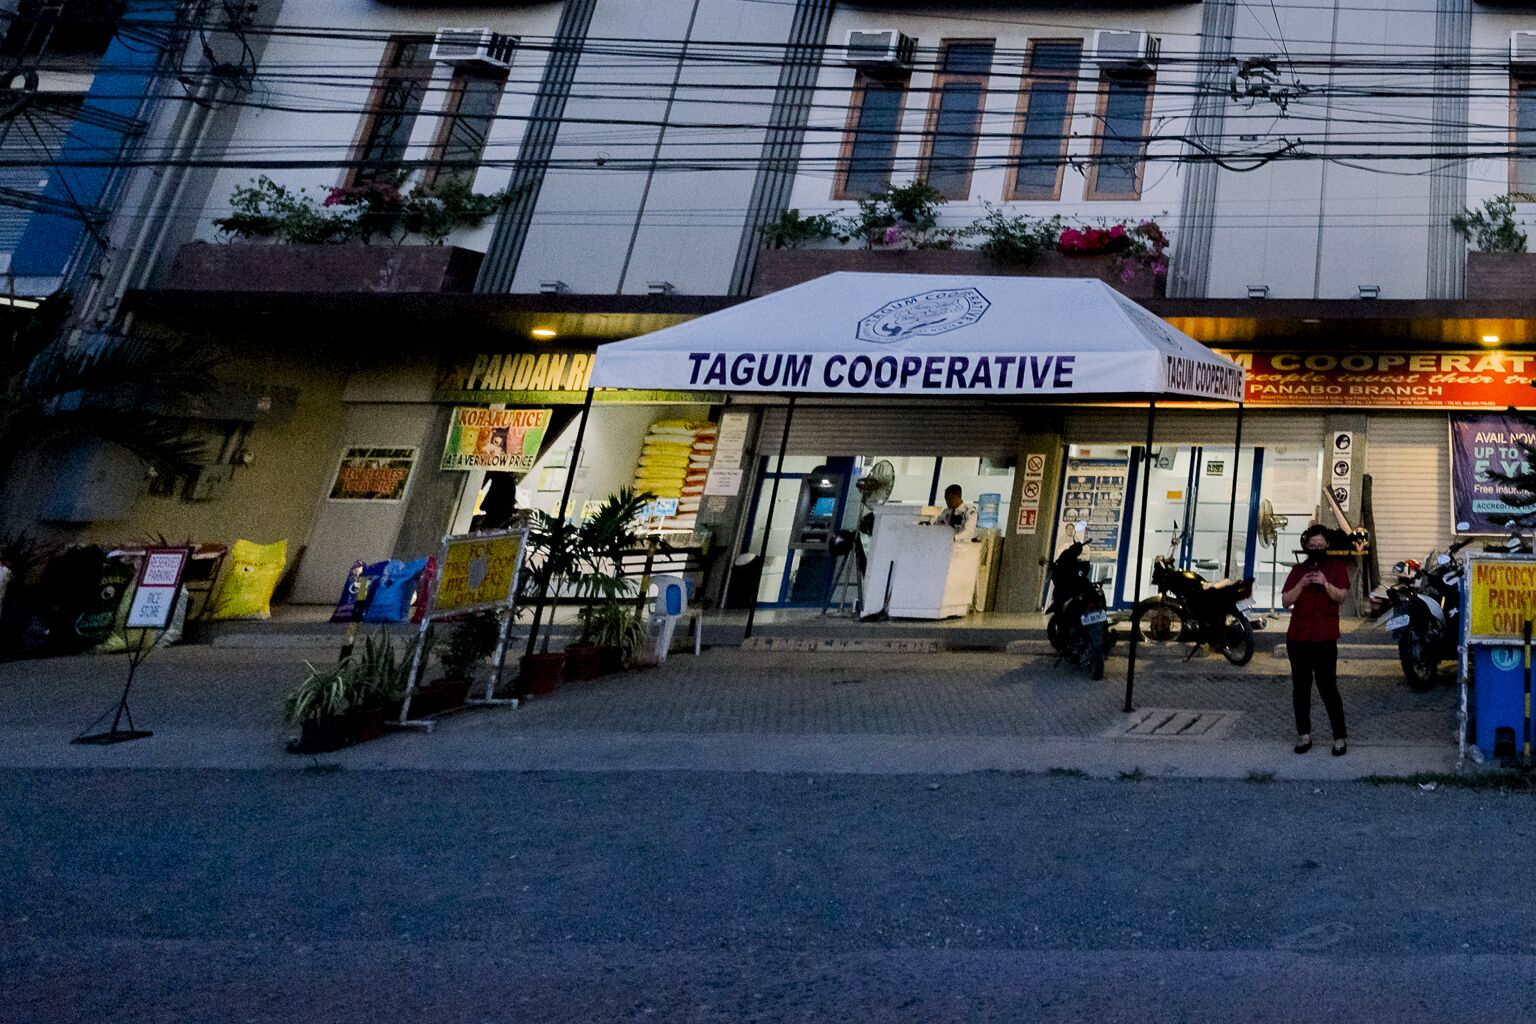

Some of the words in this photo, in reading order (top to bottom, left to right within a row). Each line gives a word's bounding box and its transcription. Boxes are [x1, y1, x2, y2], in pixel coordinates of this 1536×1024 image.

[466, 353, 568, 391] PANDAN
[687, 352, 813, 387] TAGUM
[822, 354, 1076, 389] COOPERATIVE
[1166, 355, 1195, 391] TAGUM
[1195, 360, 1243, 398] COOPERATIVE
[1249, 383, 1342, 395] PANABO
[1349, 384, 1443, 396] BRANCH
[514, 410, 544, 427] RICE
[1474, 431, 1508, 444] AVAIL
[464, 454, 486, 467] VERY
[487, 454, 509, 467] LOW
[508, 454, 534, 467] PRICE
[1474, 446, 1495, 460] UP
[1499, 447, 1519, 460] TO
[1474, 459, 1490, 483] 5
[1473, 483, 1494, 494] Free
